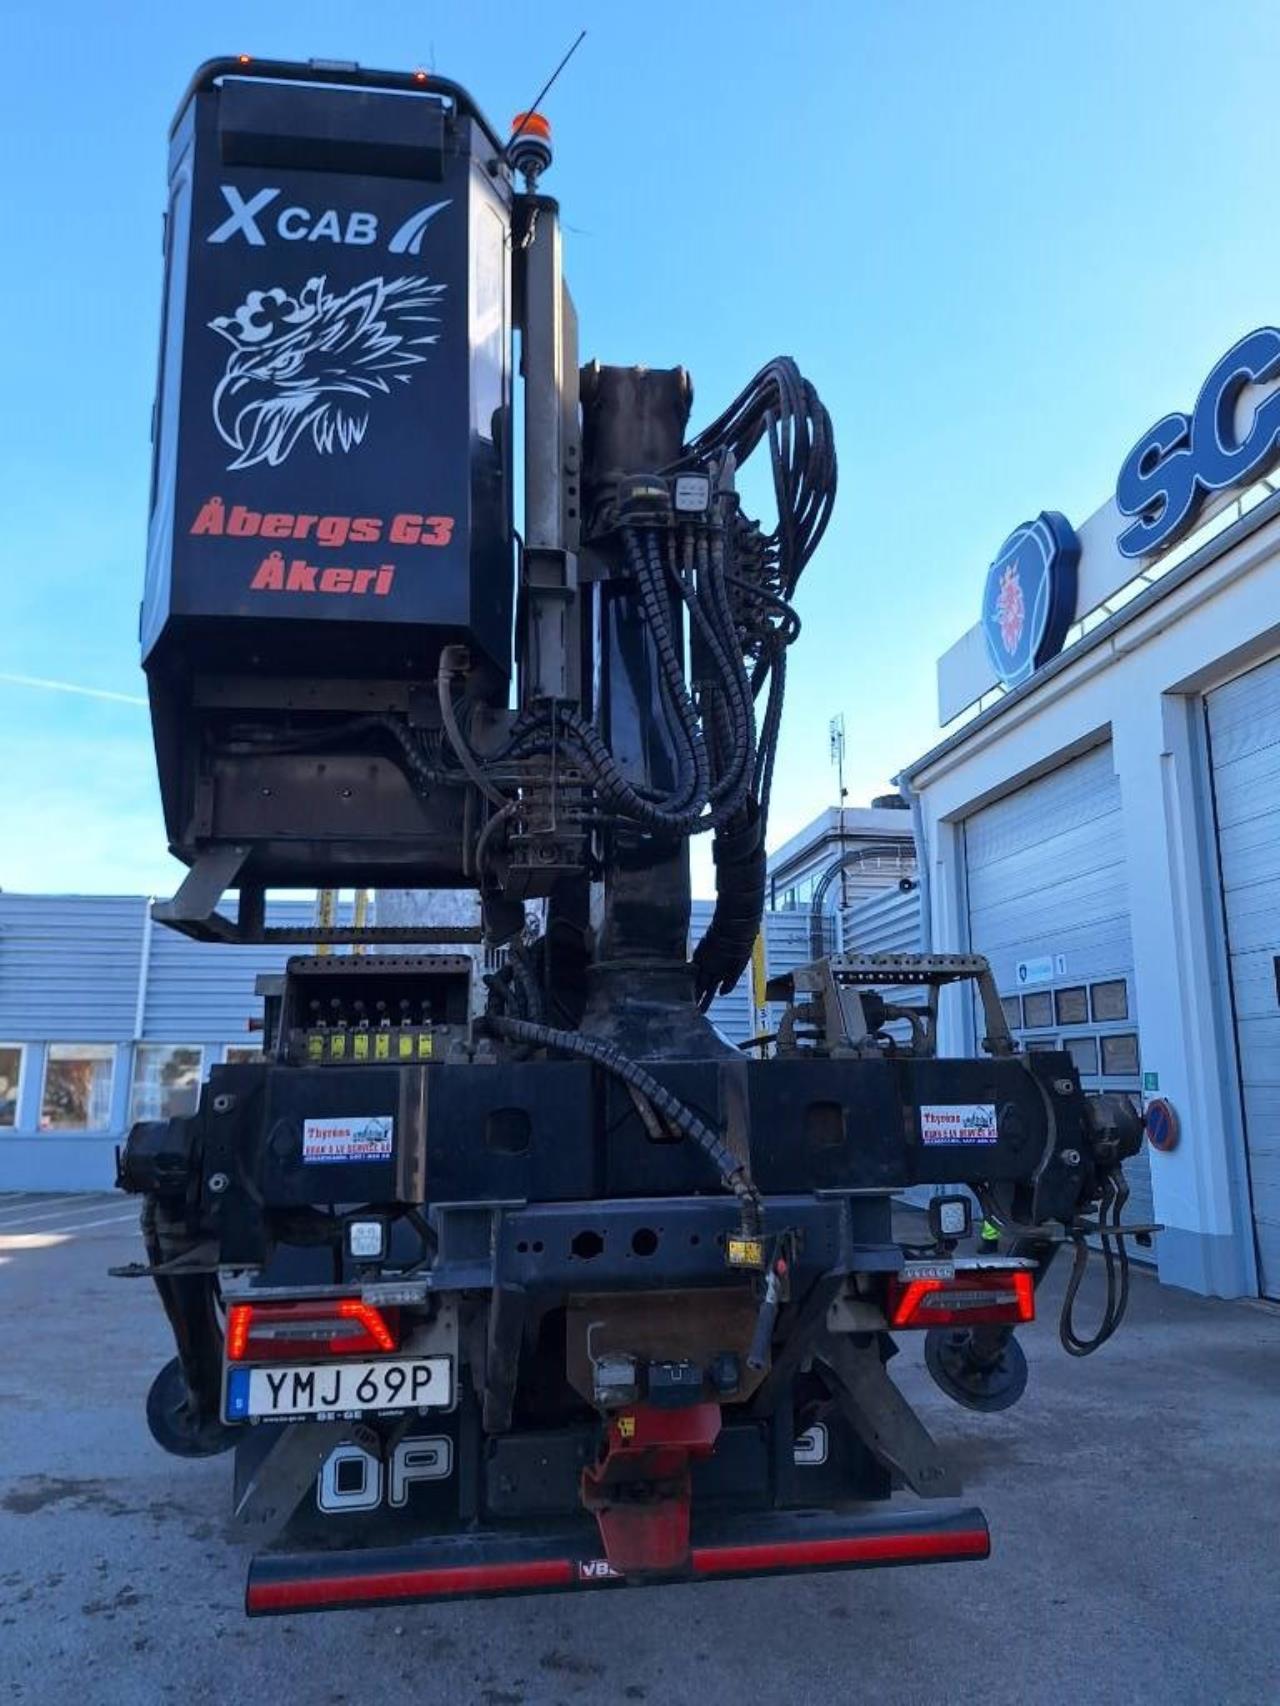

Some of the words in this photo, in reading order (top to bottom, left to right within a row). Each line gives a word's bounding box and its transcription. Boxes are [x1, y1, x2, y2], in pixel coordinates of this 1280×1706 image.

[205, 184, 282, 247] X
[276, 206, 379, 246] CAB
[189, 495, 384, 547] Åbergs
[389, 513, 456, 547] G3
[249, 550, 396, 596] Åkeri
[266, 1369, 341, 1409] YMJ
[356, 1364, 433, 1403] 69P
